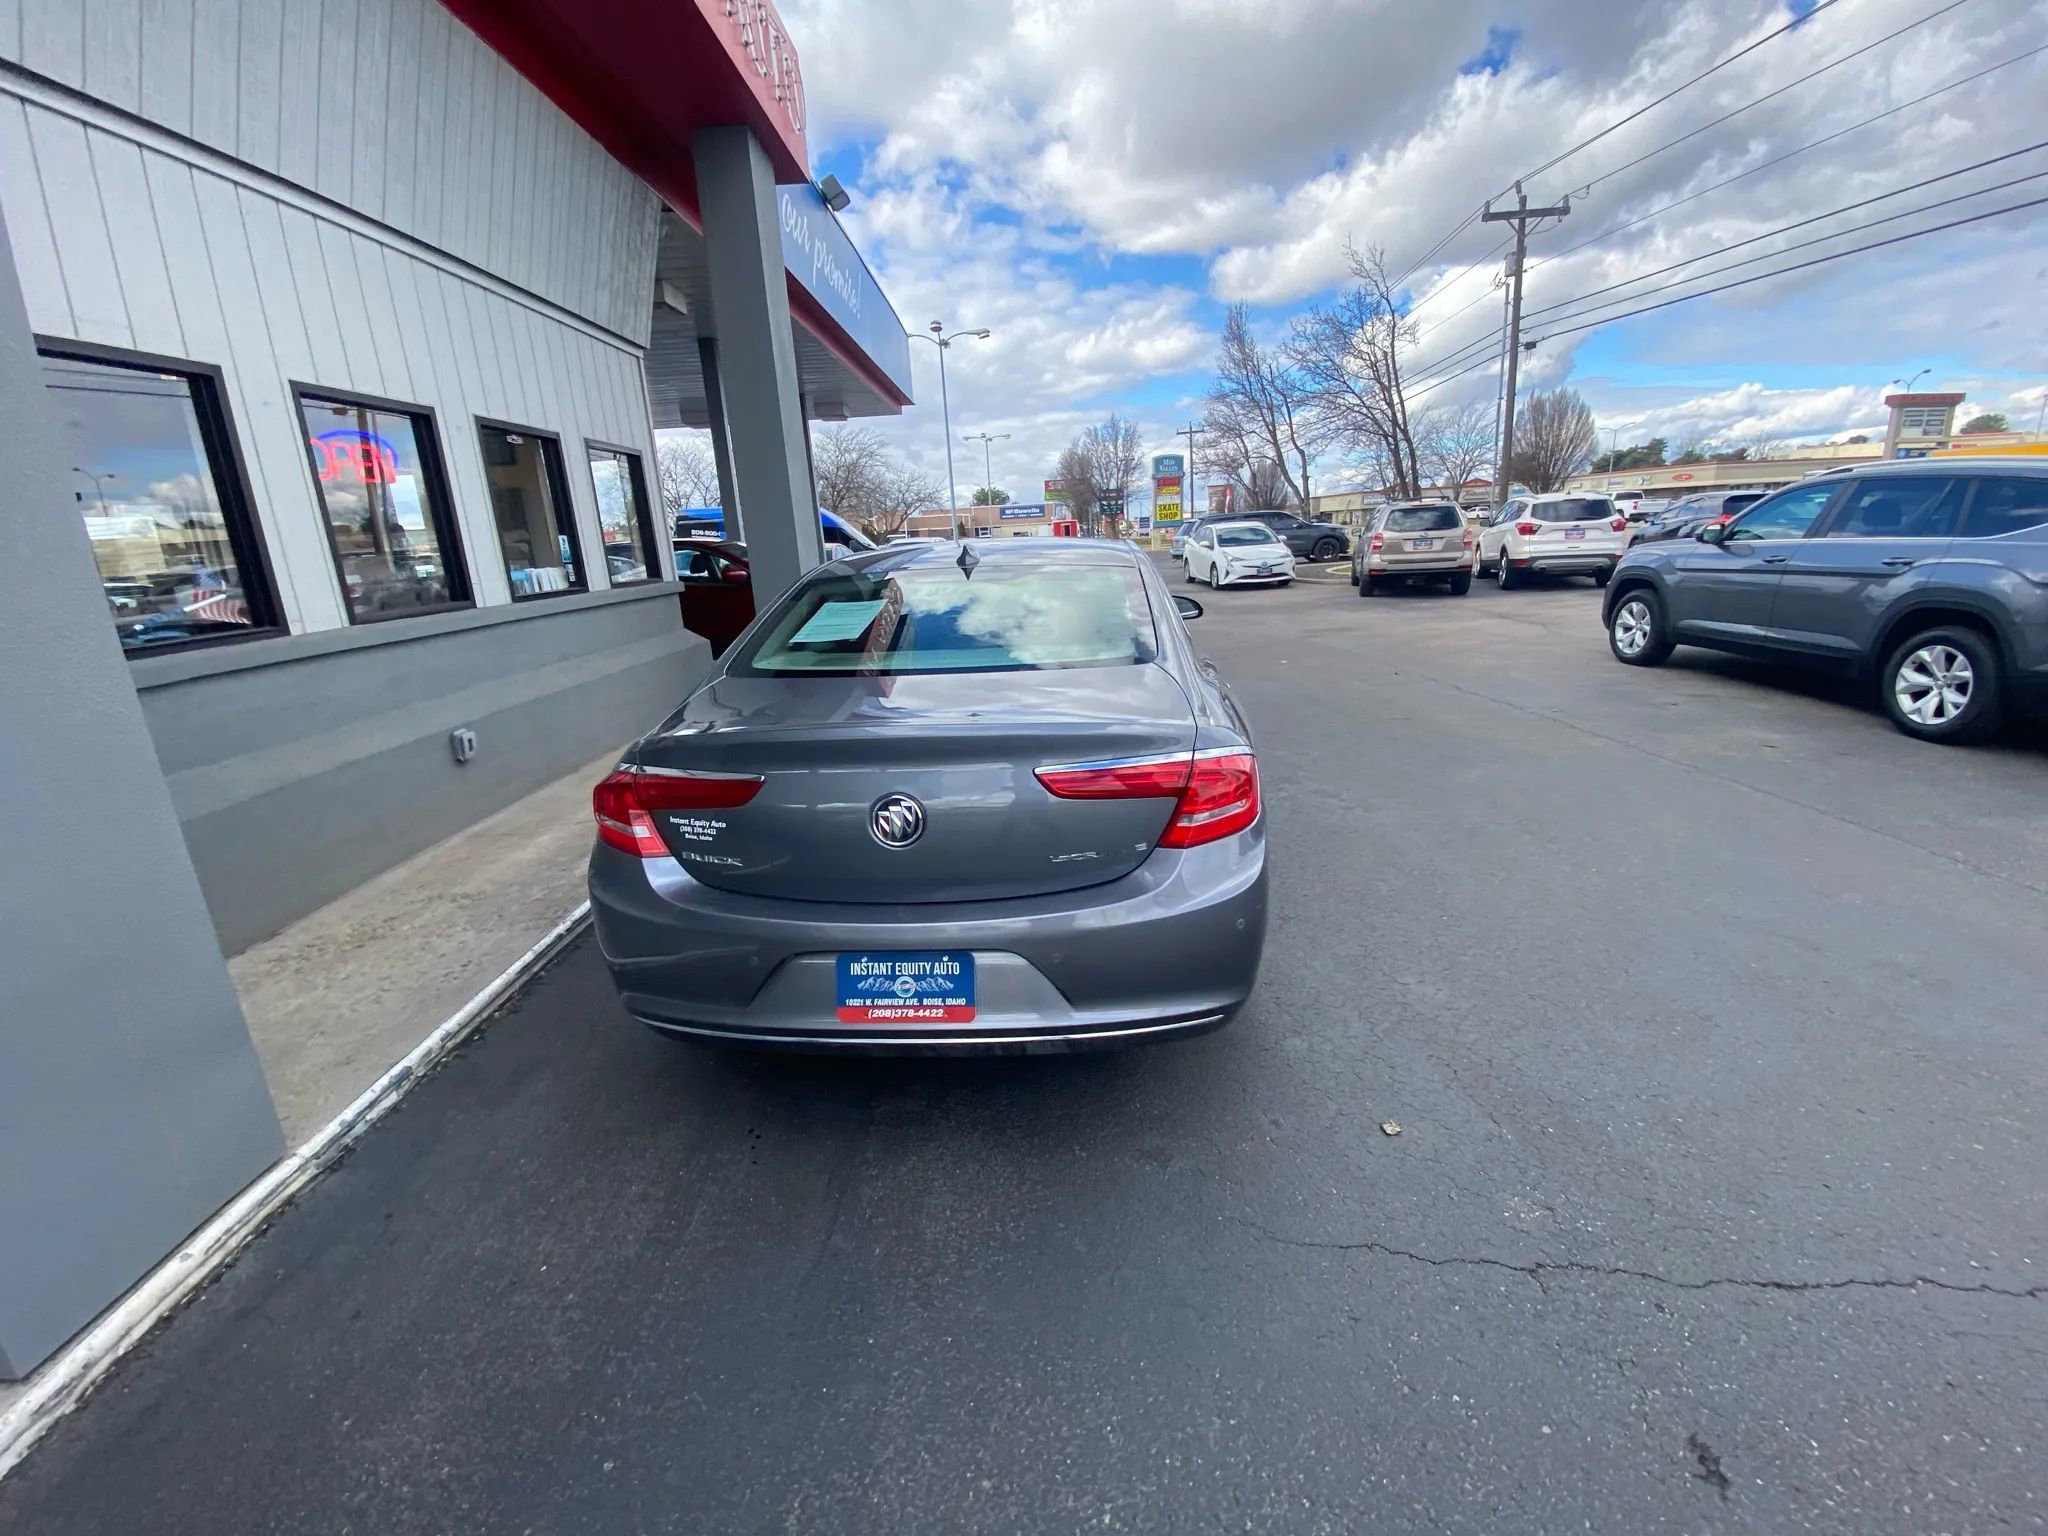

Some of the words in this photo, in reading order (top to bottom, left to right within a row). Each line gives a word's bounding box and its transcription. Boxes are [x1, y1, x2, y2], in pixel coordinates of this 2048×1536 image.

[1158, 503, 1180, 512] SKATE
[1158, 511, 1178, 520] SHOP
[669, 815, 690, 825] Instant
[690, 818, 710, 828] Equity
[710, 820, 727, 828] Auto
[681, 851, 743, 866] BUICK
[850, 962, 893, 976] INSTANT
[895, 961, 932, 976] EQUITY
[933, 961, 960, 975] AUTO
[923, 998, 944, 1006] BOISE,
[945, 998, 967, 1006] IDAHO
[868, 1009, 944, 1018] (208)378-4422
